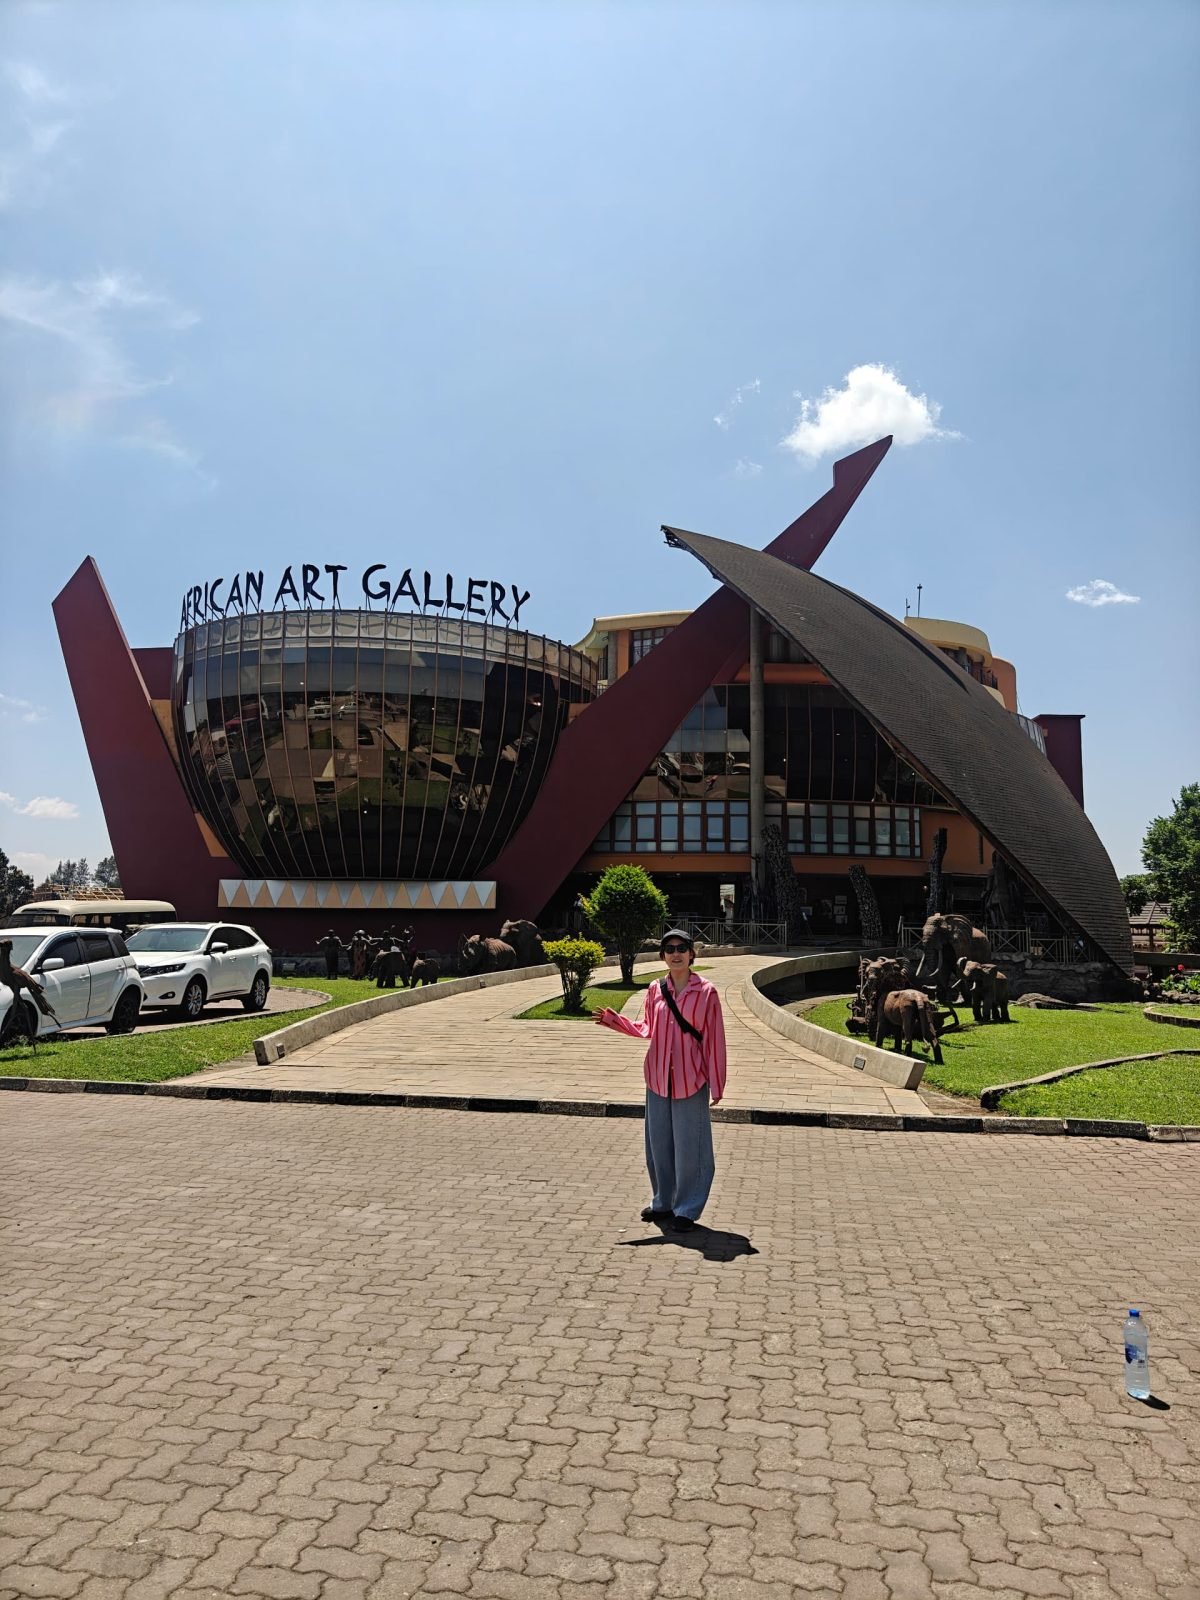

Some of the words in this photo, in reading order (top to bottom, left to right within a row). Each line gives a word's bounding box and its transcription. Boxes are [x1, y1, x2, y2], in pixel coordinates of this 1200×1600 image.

[180, 570, 264, 628] AFRICAN
[274, 563, 348, 605] ART
[362, 563, 531, 623] GALLERY
